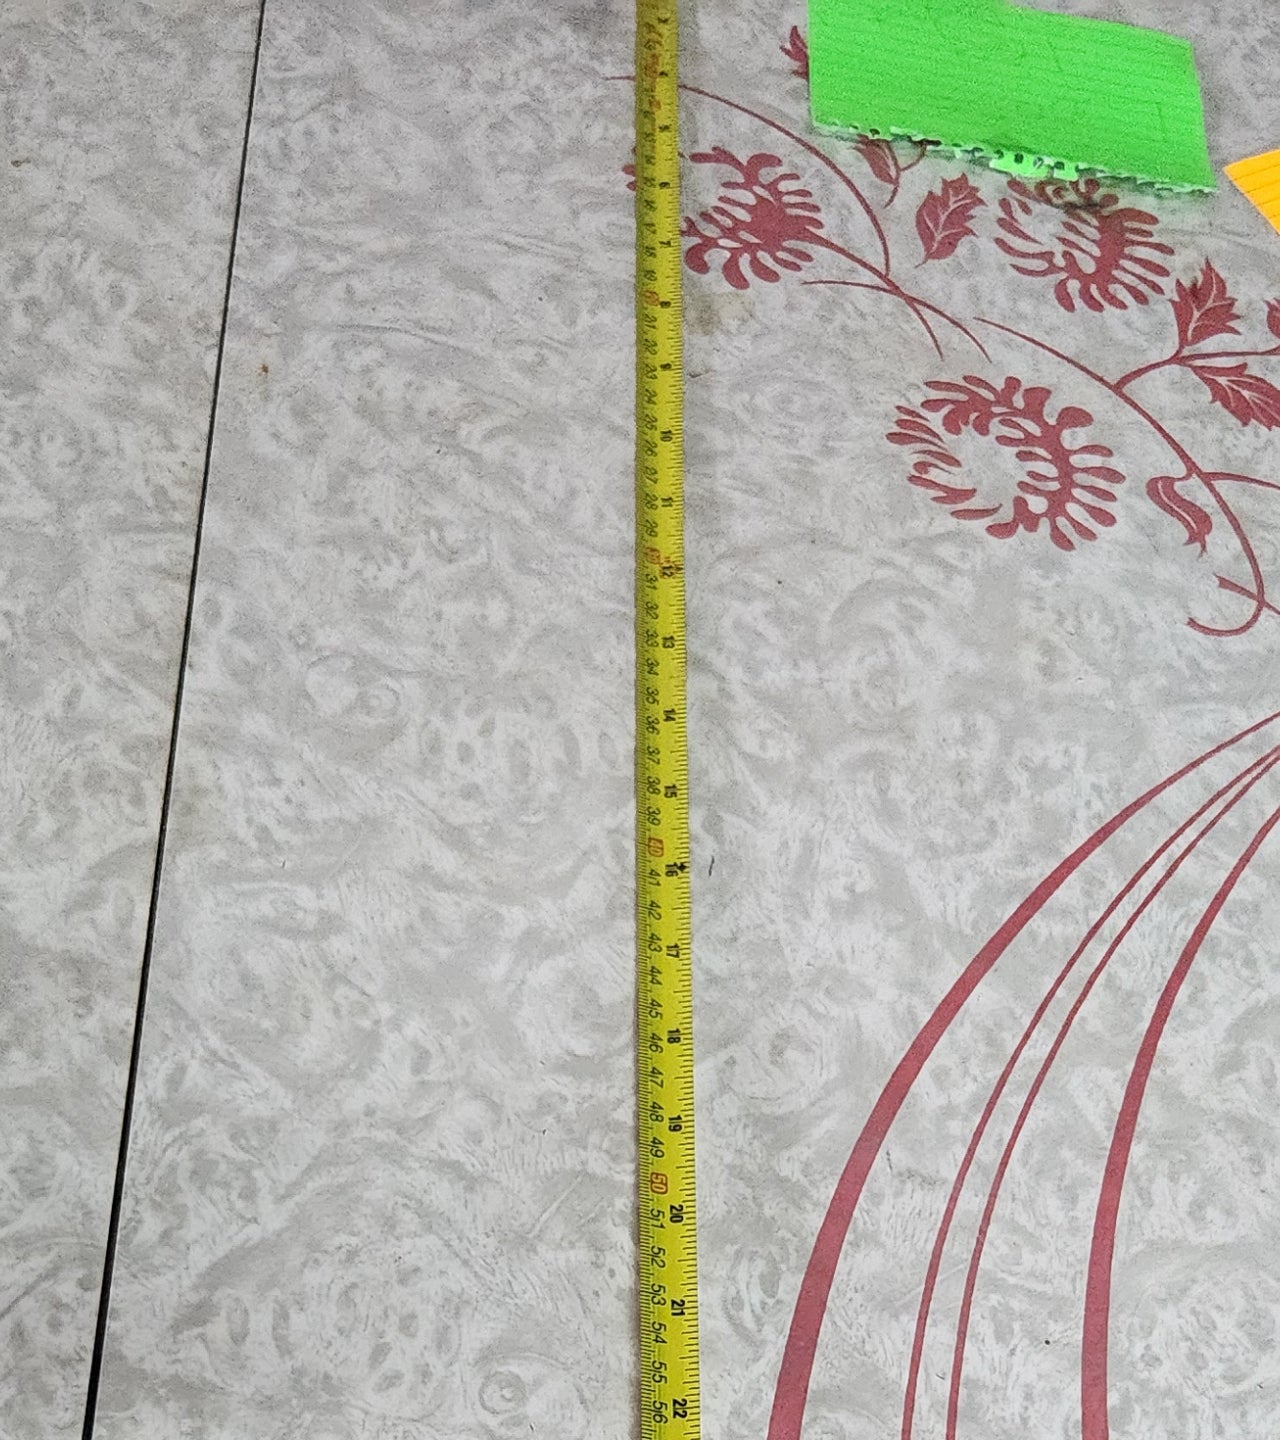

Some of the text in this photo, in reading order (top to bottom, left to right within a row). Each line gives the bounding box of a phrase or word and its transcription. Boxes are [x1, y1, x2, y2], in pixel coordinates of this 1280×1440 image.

[659, 182, 670, 190] 6
[645, 200, 657, 212] 16
[645, 223, 657, 235] 17
[645, 246, 657, 258] 18
[645, 269, 657, 282] 19
[645, 314, 657, 329] 21
[645, 339, 658, 355] 22
[645, 363, 658, 379] 23
[660, 363, 672, 371] 9
[645, 388, 658, 405] 24
[645, 414, 658, 431] 25
[661, 430, 672, 442] 10
[645, 440, 658, 457] 26
[645, 466, 658, 484] 27
[645, 493, 658, 510] 28
[661, 497, 672, 508] 11
[645, 519, 658, 537] 29
[662, 565, 673, 578] 12
[646, 574, 658, 590] 31
[646, 601, 659, 620] 32
[646, 629, 659, 647] 33
[662, 635, 675, 649] 13
[646, 658, 660, 676] 34
[646, 687, 660, 705] 35
[663, 708, 676, 722] 14
[646, 716, 660, 735] 36
[647, 746, 660, 765] 37
[647, 776, 660, 795] 38
[664, 784, 677, 799] 15
[647, 806, 661, 826] 39
[648, 837, 663, 857] 40
[649, 869, 661, 886] 41
[665, 862, 678, 877] 16
[649, 900, 662, 920] 42
[649, 933, 662, 952] 43
[666, 943, 679, 958] 17
[649, 965, 663, 986] 44
[649, 998, 663, 1019] 45
[649, 1033, 663, 1054] 46
[667, 1028, 681, 1044] 18
[650, 1067, 664, 1088] 47
[650, 1102, 664, 1123] 48
[668, 1115, 682, 1132] 19
[650, 1137, 665, 1158] 49
[651, 1172, 667, 1194] 50
[650, 1208, 666, 1230] 51
[670, 1204, 683, 1223] 20
[651, 1245, 666, 1268] 52
[652, 1283, 666, 1306] 53
[671, 1299, 685, 1316] 21
[652, 1321, 667, 1344] 54
[653, 1360, 667, 1384] 55
[653, 1400, 668, 1424] 56
[673, 1398, 687, 1419] 22
